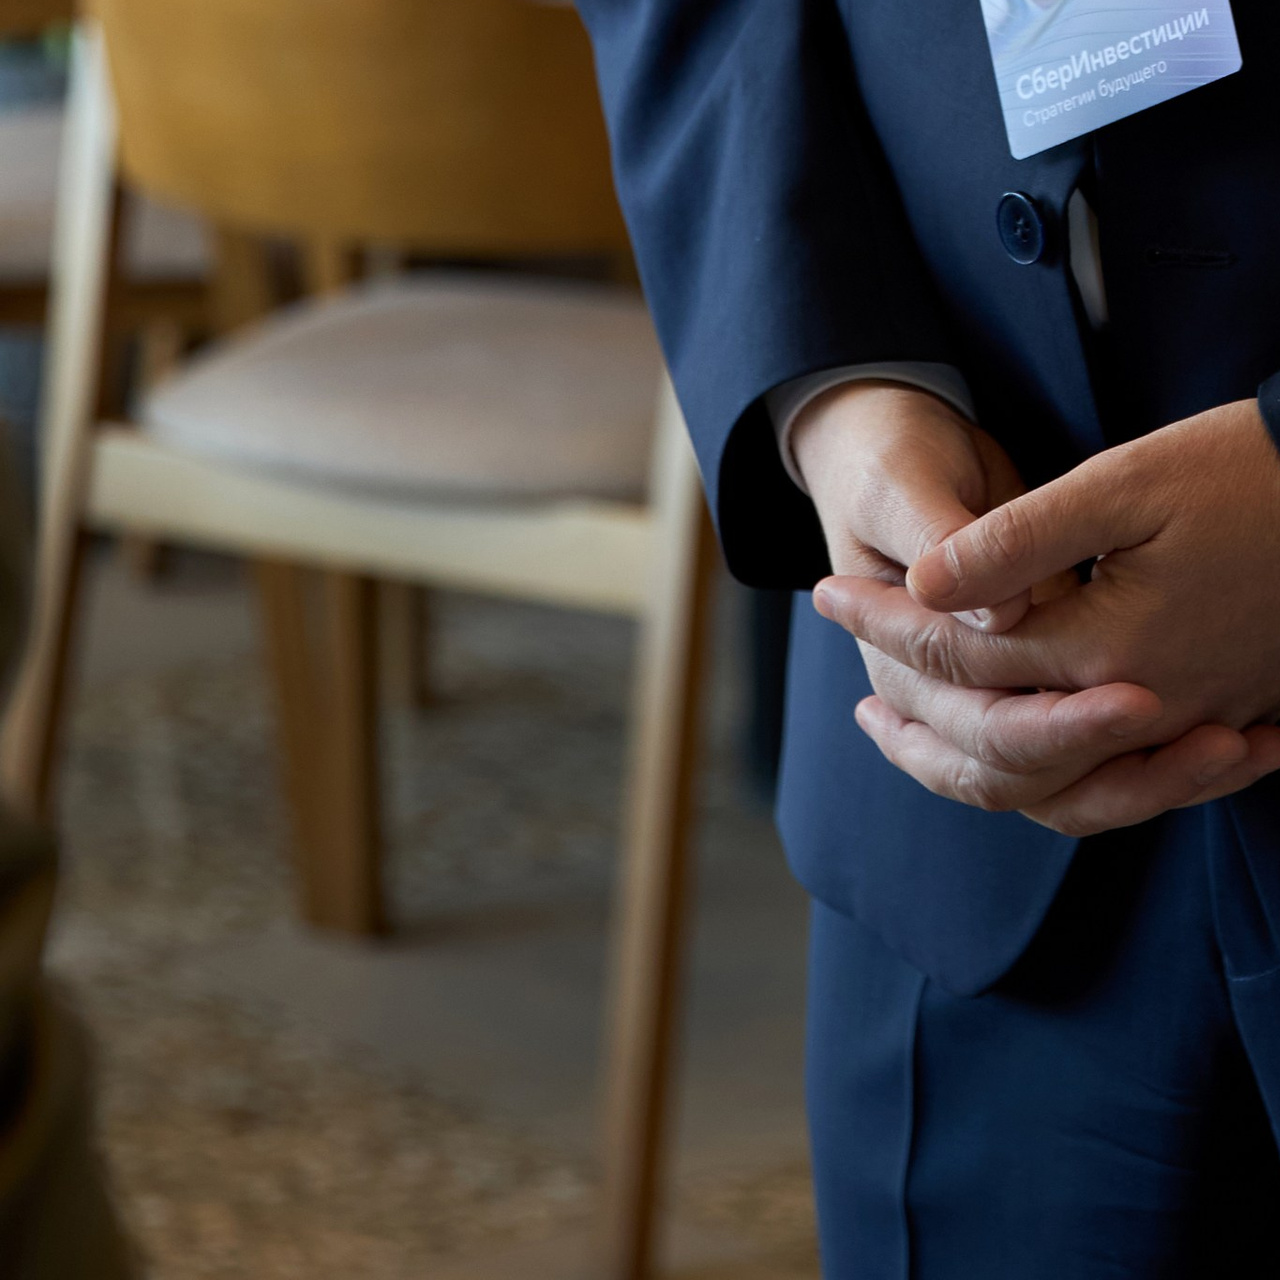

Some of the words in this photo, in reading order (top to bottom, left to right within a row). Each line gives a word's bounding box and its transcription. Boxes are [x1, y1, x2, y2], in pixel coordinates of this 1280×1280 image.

[1016, 7, 1210, 100] СберИнвестиции
[1023, 88, 1097, 127] Стратегии
[1099, 60, 1168, 100] будущего
